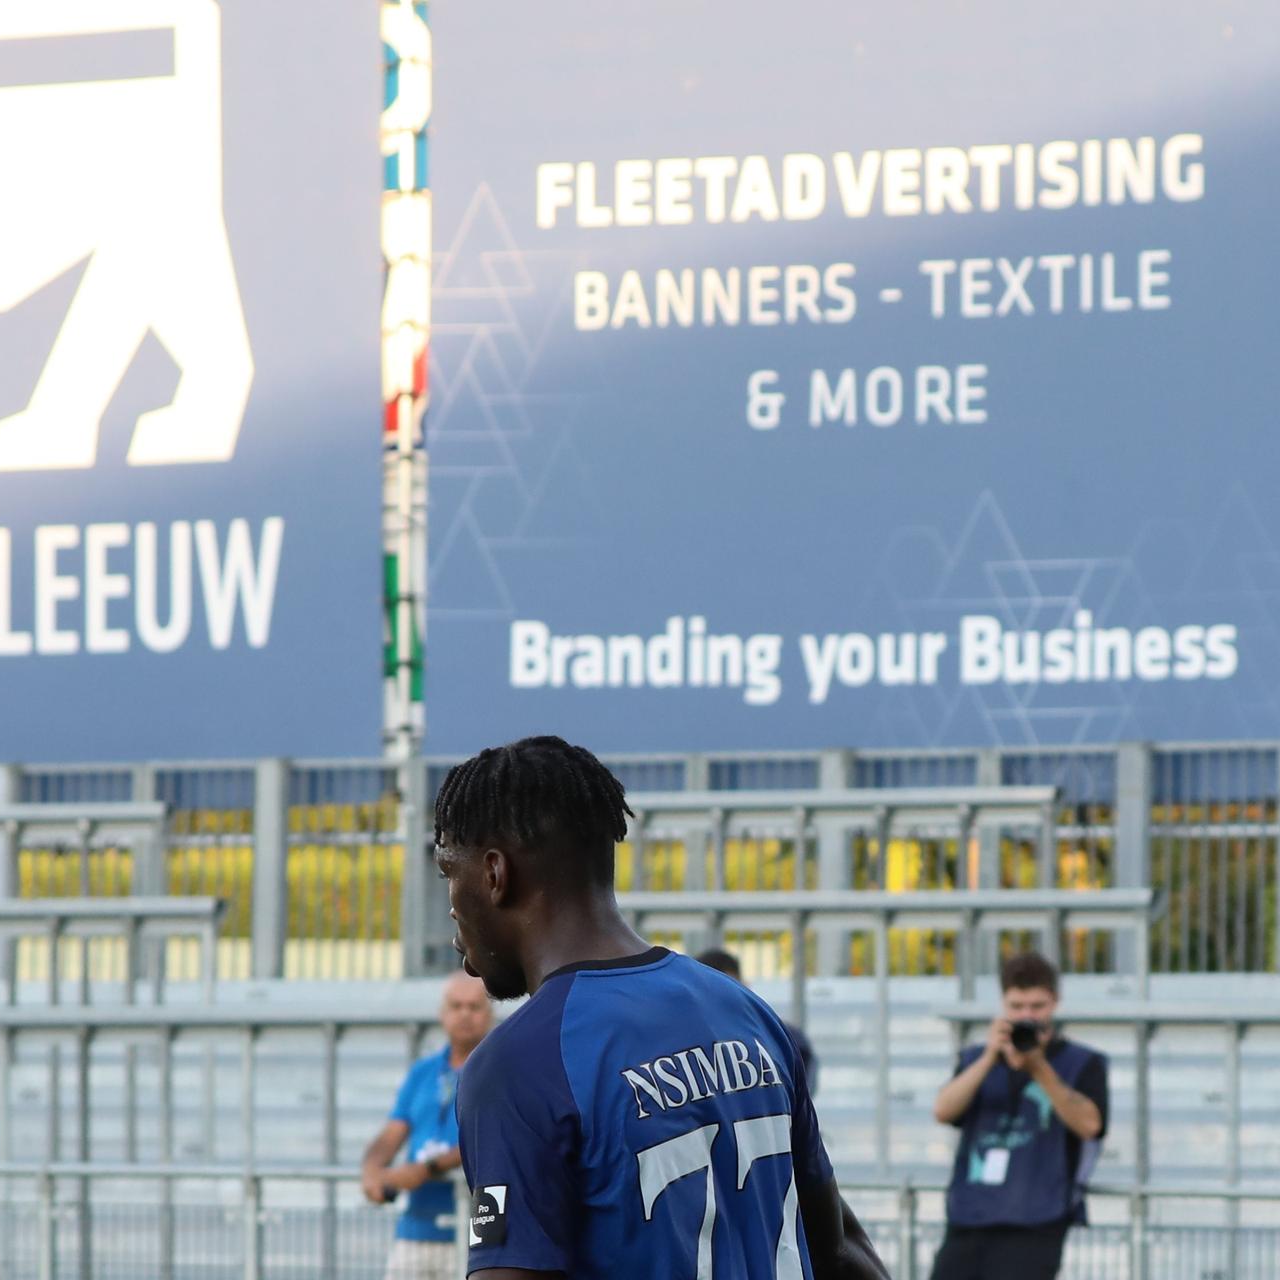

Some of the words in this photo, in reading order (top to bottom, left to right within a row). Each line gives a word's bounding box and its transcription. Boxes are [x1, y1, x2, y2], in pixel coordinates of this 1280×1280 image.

[536, 133, 1205, 229] FLEETADVERTISING
[574, 262, 856, 331] BANNERS
[919, 250, 1171, 318] TEXTILE
[747, 370, 785, 429] &
[809, 364, 987, 427] MORE
[510, 616, 782, 705] Branding
[801, 632, 947, 703] your
[960, 609, 1238, 684] Business
[622, 1038, 784, 1119] NSIMBA
[473, 1215, 496, 1225] League
[478, 1204, 490, 1214] Pro
